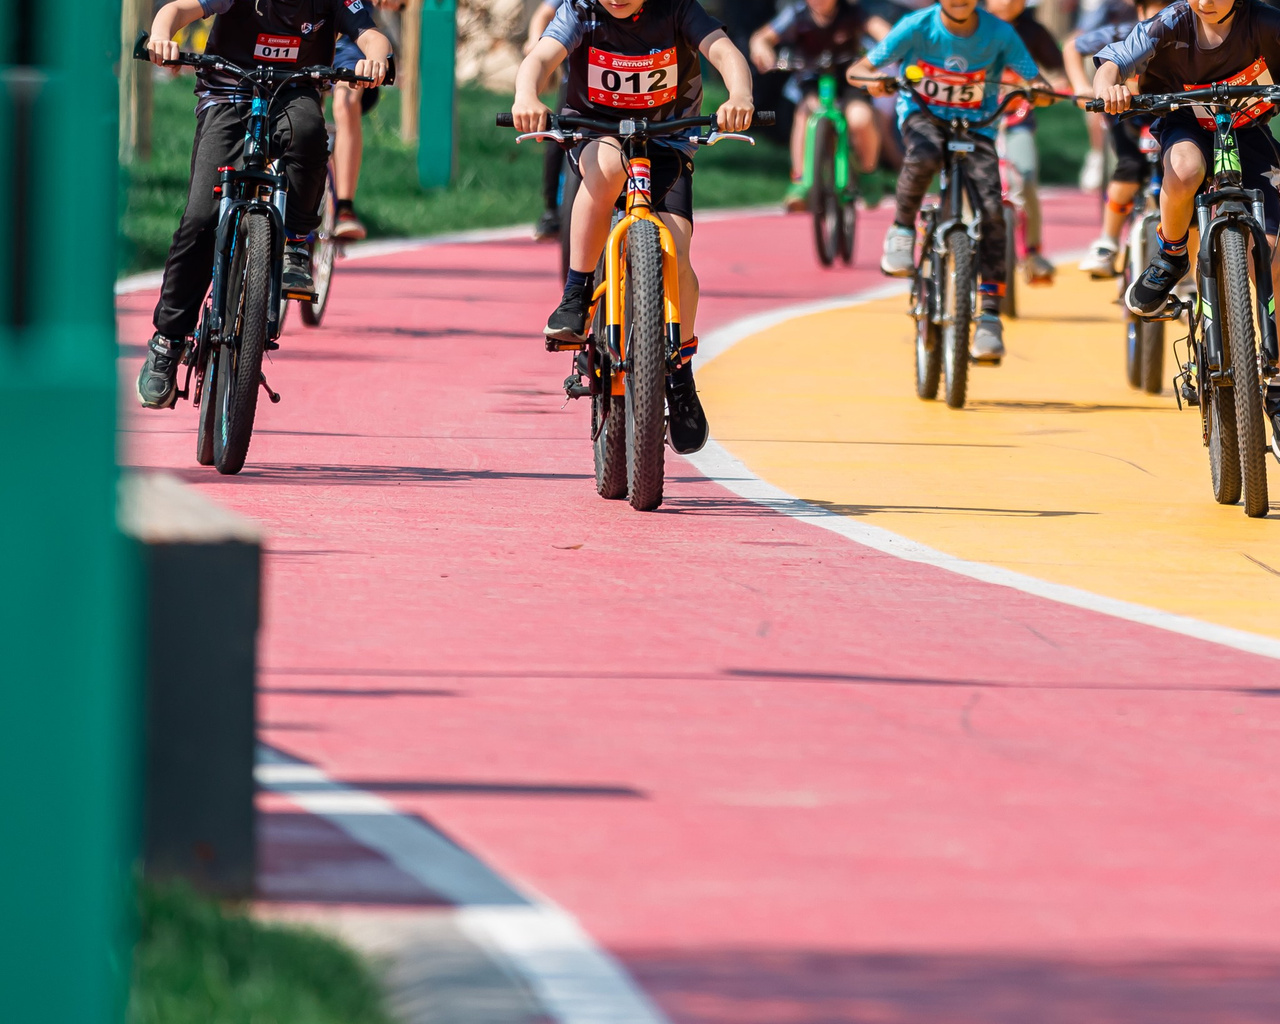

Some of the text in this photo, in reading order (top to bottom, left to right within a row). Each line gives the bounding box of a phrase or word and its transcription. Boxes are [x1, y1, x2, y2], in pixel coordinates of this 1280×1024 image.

[262, 46, 290, 58] 011
[601, 69, 668, 94] 012
[924, 79, 974, 103] 015
